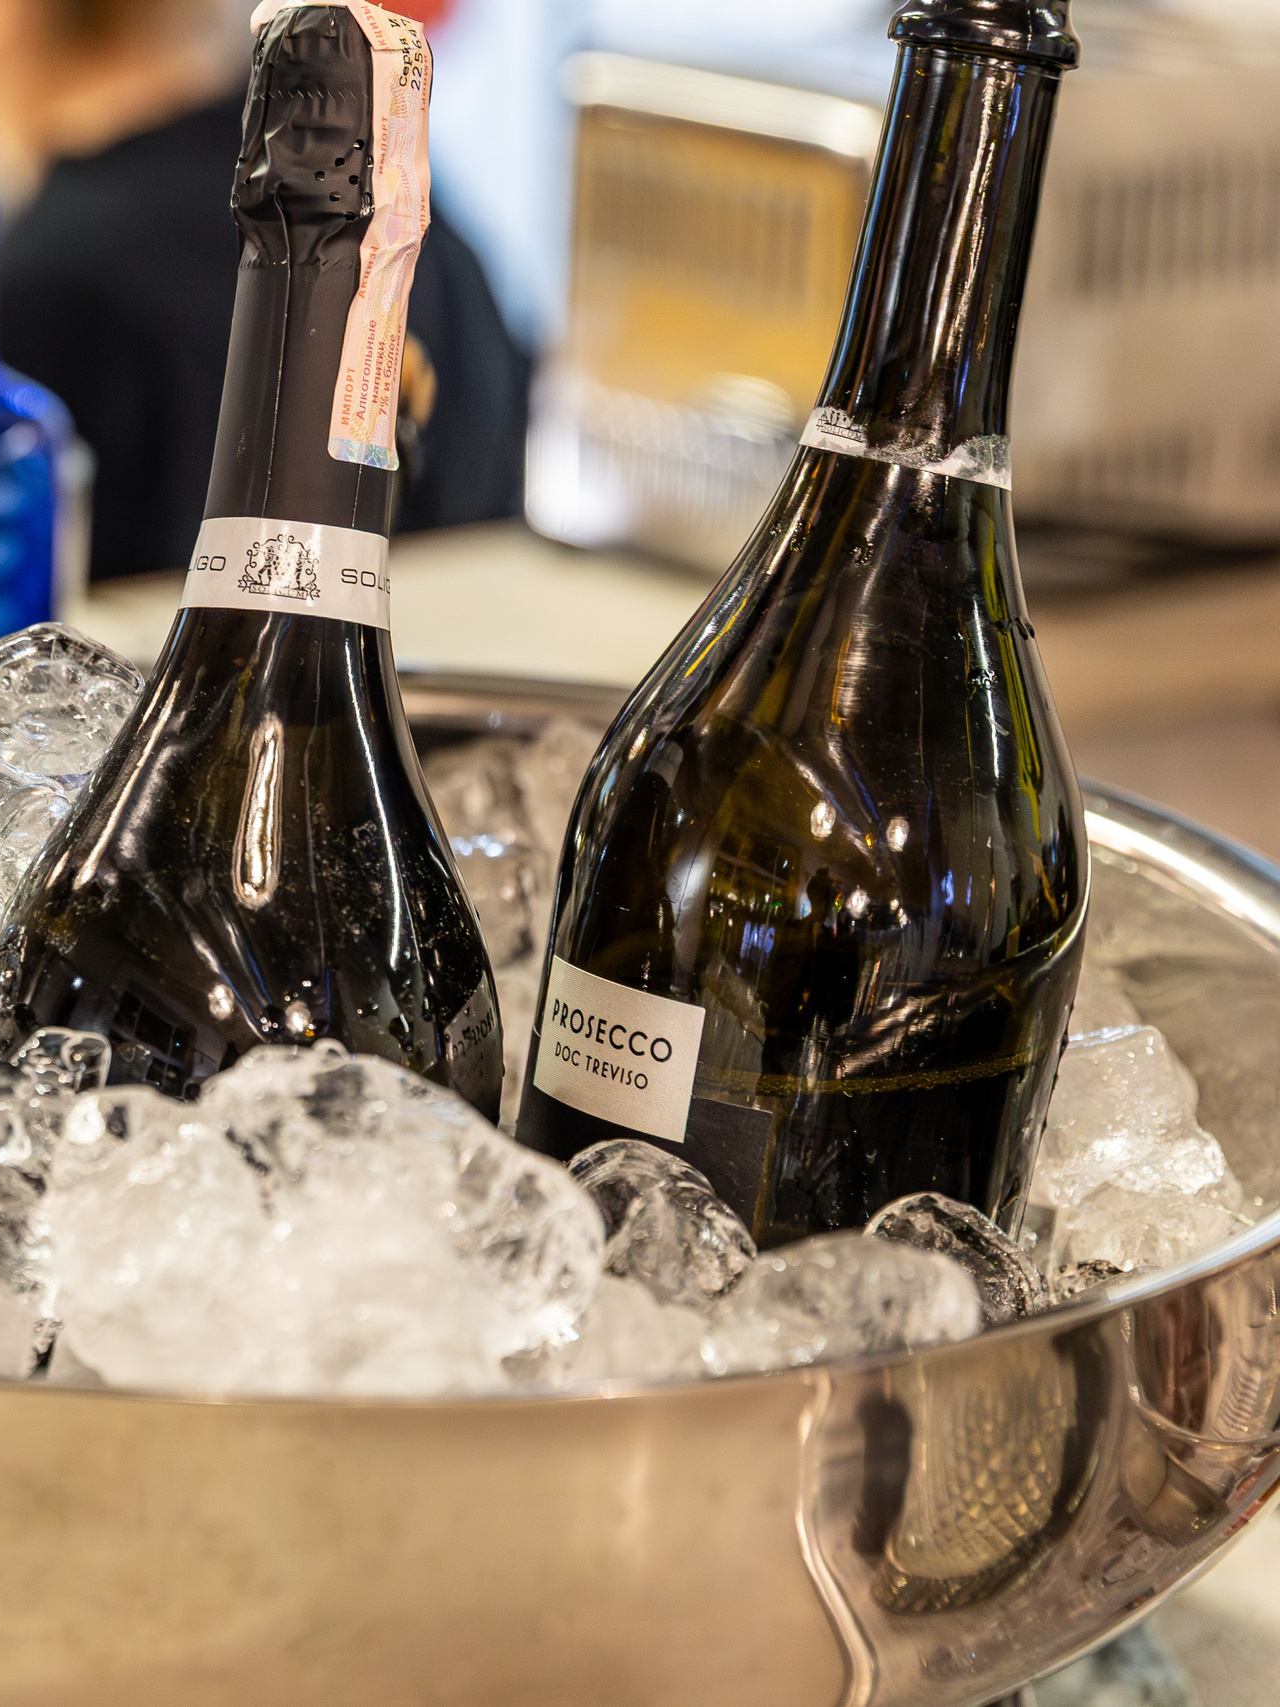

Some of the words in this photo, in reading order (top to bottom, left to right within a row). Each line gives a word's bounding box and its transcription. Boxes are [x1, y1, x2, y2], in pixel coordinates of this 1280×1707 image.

[361, 5, 389, 50] КЦИЗЫ
[399, 38, 412, 86] Серия
[379, 116, 388, 174] ИМПОРТ
[356, 320, 377, 420] Алкогольные
[372, 341, 385, 404] напитки
[383, 334, 396, 378] более
[341, 366, 356, 426] ИМПОРТ
[379, 396, 390, 415] 7%
[552, 998, 672, 1062] PROSECCO
[555, 1041, 581, 1067] DOC
[585, 1055, 648, 1089] TREVISO
